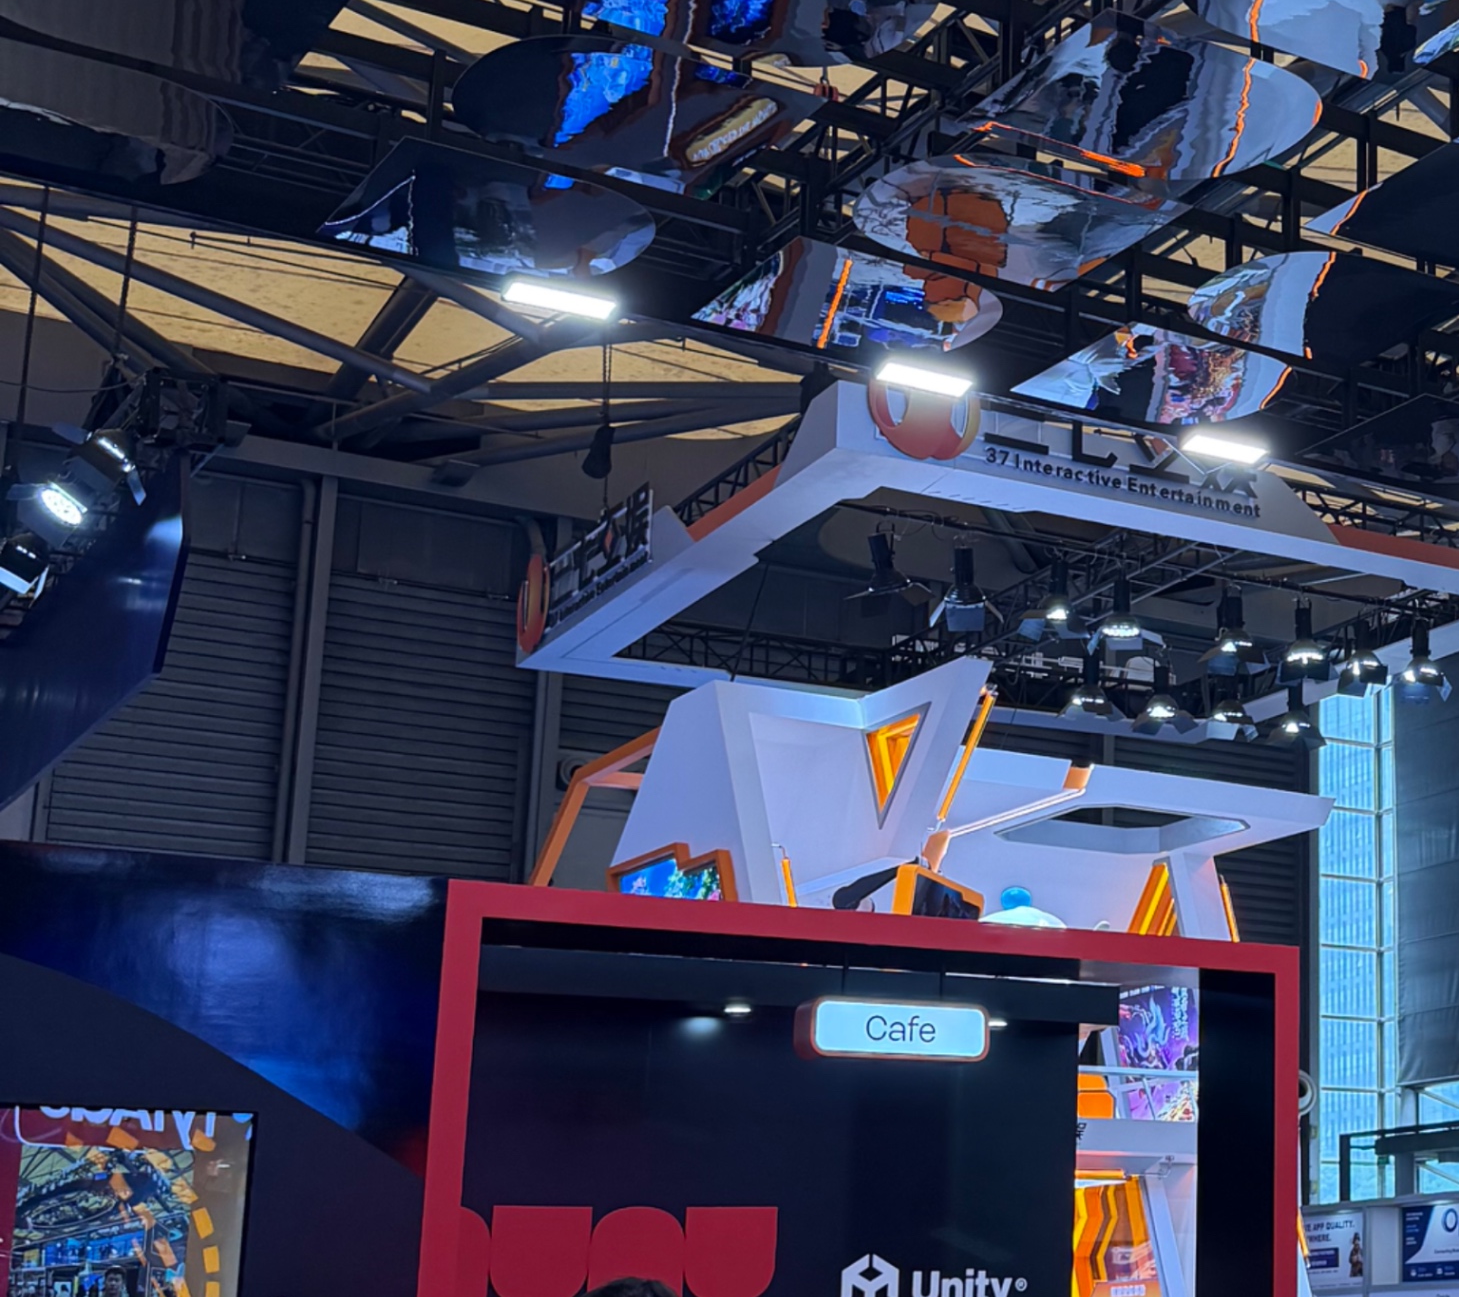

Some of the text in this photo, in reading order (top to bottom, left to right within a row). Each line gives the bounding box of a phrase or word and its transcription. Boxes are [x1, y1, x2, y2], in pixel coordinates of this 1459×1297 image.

[984, 446, 1261, 518] 37 Interactive Entertainment
[865, 1014, 937, 1043] Cafe
